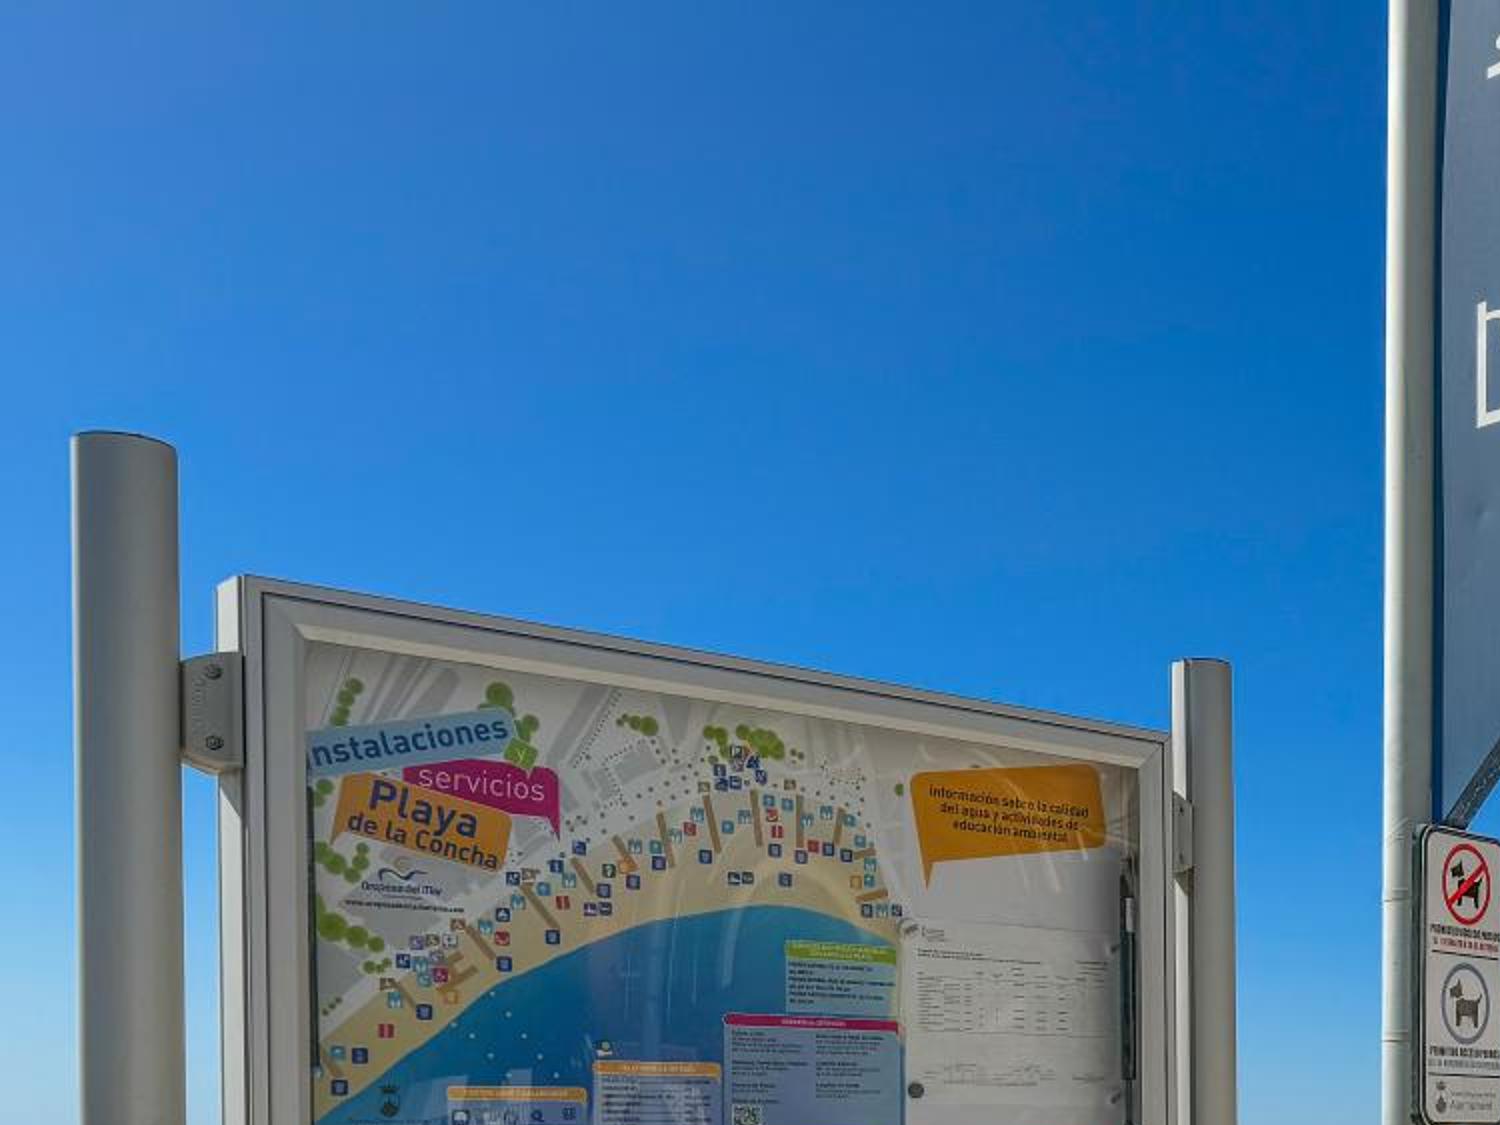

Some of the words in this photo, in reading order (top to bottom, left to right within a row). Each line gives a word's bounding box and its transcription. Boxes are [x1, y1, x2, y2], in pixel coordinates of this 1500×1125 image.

[311, 718, 509, 767] nstalaciones
[516, 750, 525, 763] y
[418, 768, 545, 802] servicios
[369, 779, 478, 838] Playa
[940, 802, 959, 814] del
[347, 812, 377, 836] de
[385, 821, 408, 846] la
[415, 831, 499, 871] Concha
